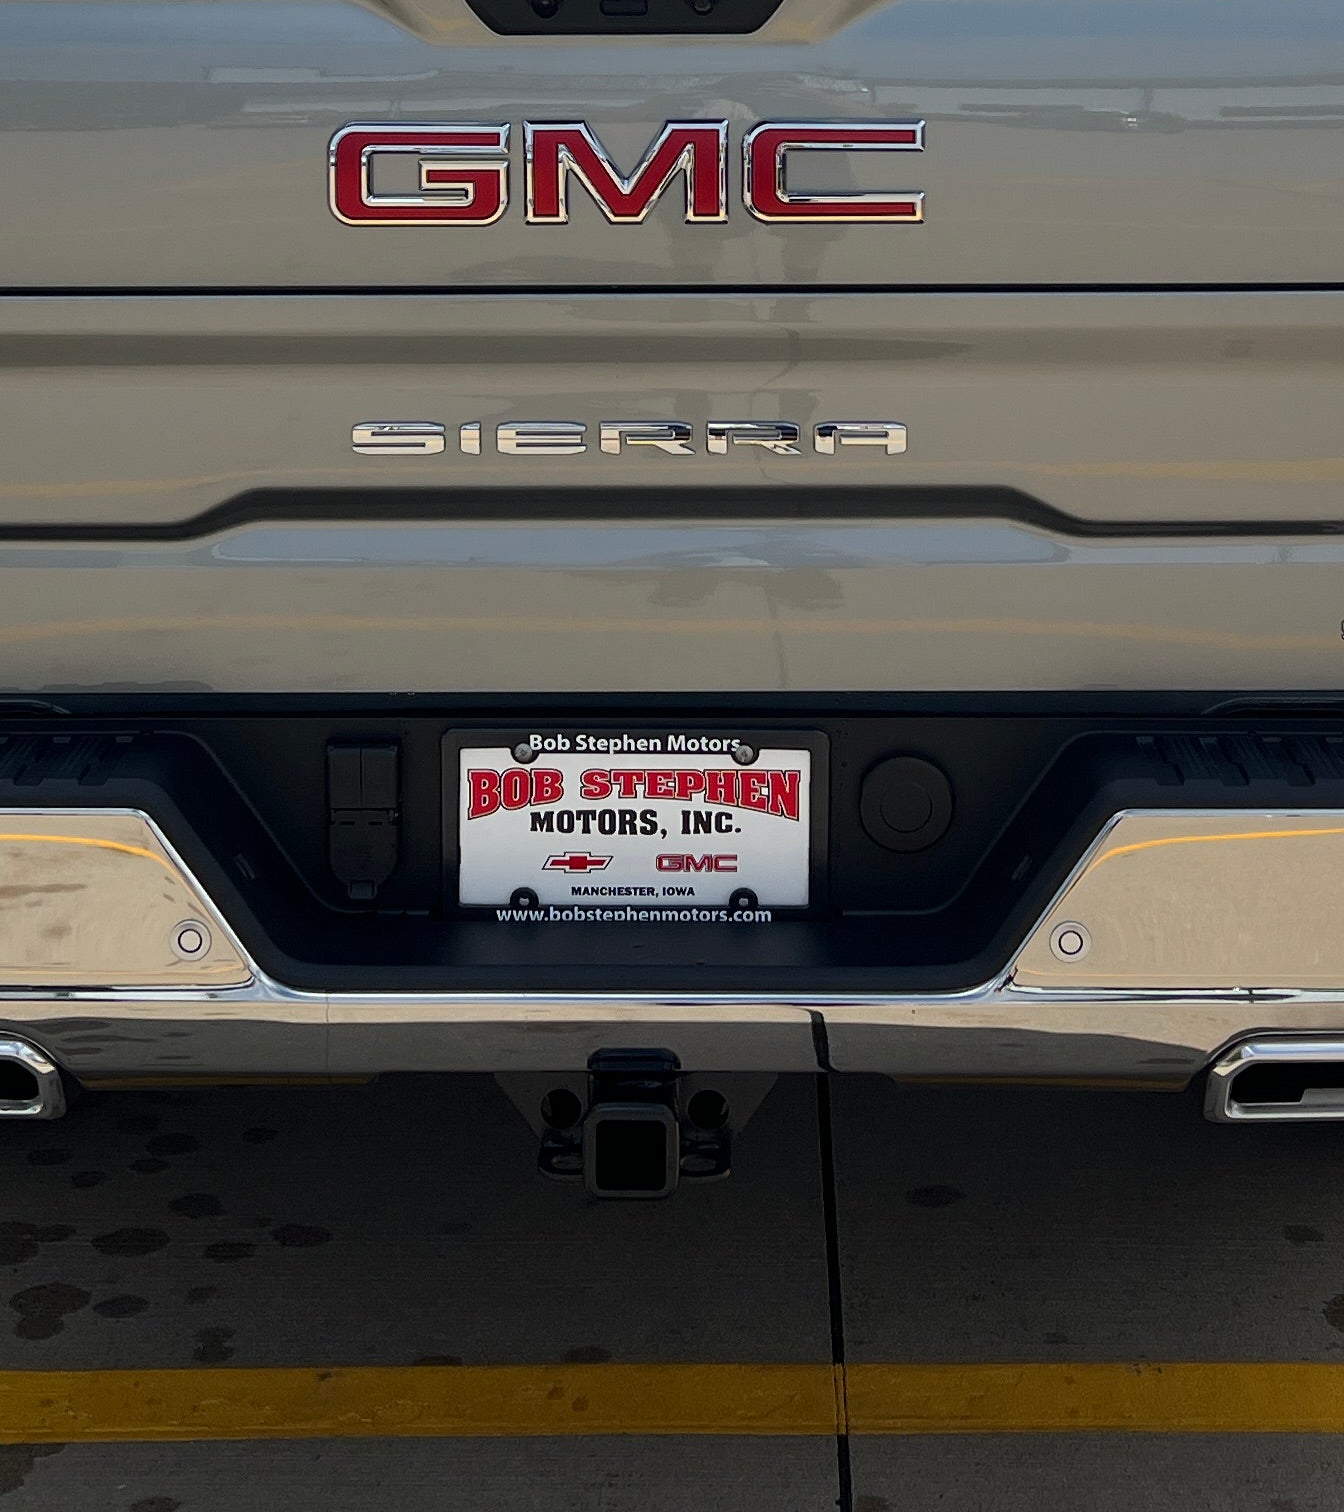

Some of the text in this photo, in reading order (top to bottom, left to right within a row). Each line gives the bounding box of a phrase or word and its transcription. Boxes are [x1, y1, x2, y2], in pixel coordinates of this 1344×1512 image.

[328, 119, 926, 226] GMC
[351, 420, 909, 456] SIERRA
[529, 734, 741, 755] Bob Stephen Motors
[467, 768, 801, 822] BOB STEPHEN
[530, 809, 742, 839] MOTORS, INC.
[656, 853, 738, 873] GMC
[571, 886, 696, 898] MANCHESTER, IOWA
[496, 906, 772, 922] www.bobstephenmotors.com
